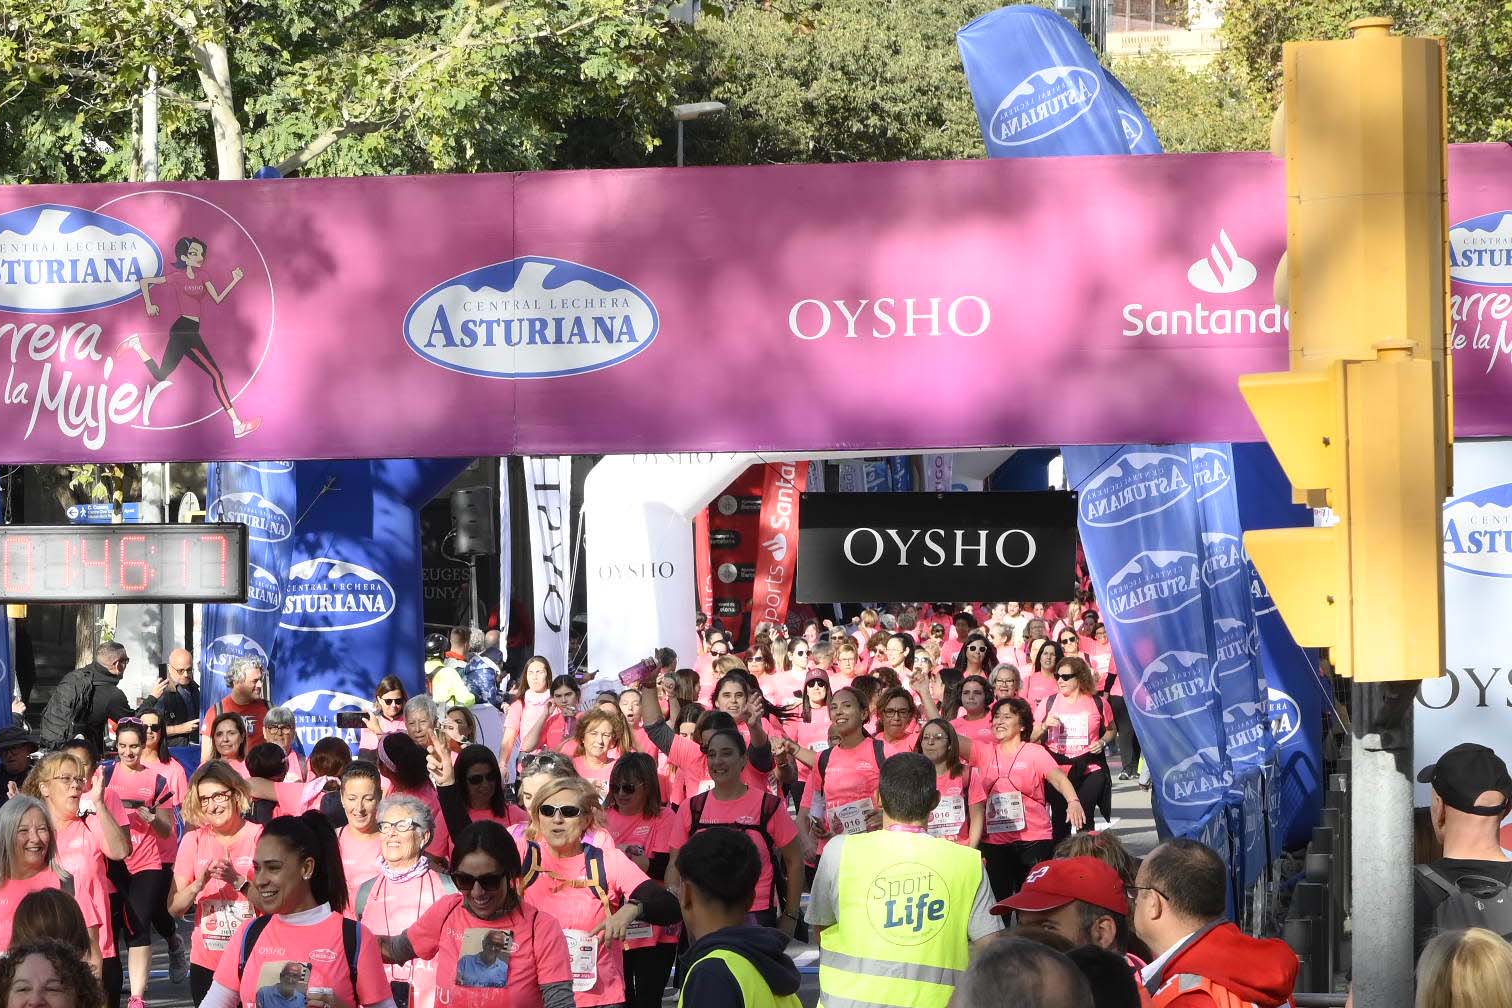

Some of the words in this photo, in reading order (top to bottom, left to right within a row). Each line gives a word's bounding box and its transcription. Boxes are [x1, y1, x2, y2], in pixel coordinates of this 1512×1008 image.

[66, 240, 138, 252] LECHERA
[463, 299, 541, 312] CENTRAL
[549, 297, 630, 311] LECHERA
[789, 296, 990, 340] OYSHO
[424, 304, 639, 351] ASTURIANA
[1473, 321, 1490, 350] la
[4, 367, 29, 404] la
[24, 357, 173, 451] Mujer
[3, 534, 229, 592] 01:46:17
[844, 527, 1037, 568] OYSHO
[333, 583, 382, 591] LECHERA
[873, 872, 935, 900] Sport
[884, 893, 945, 932] Life
